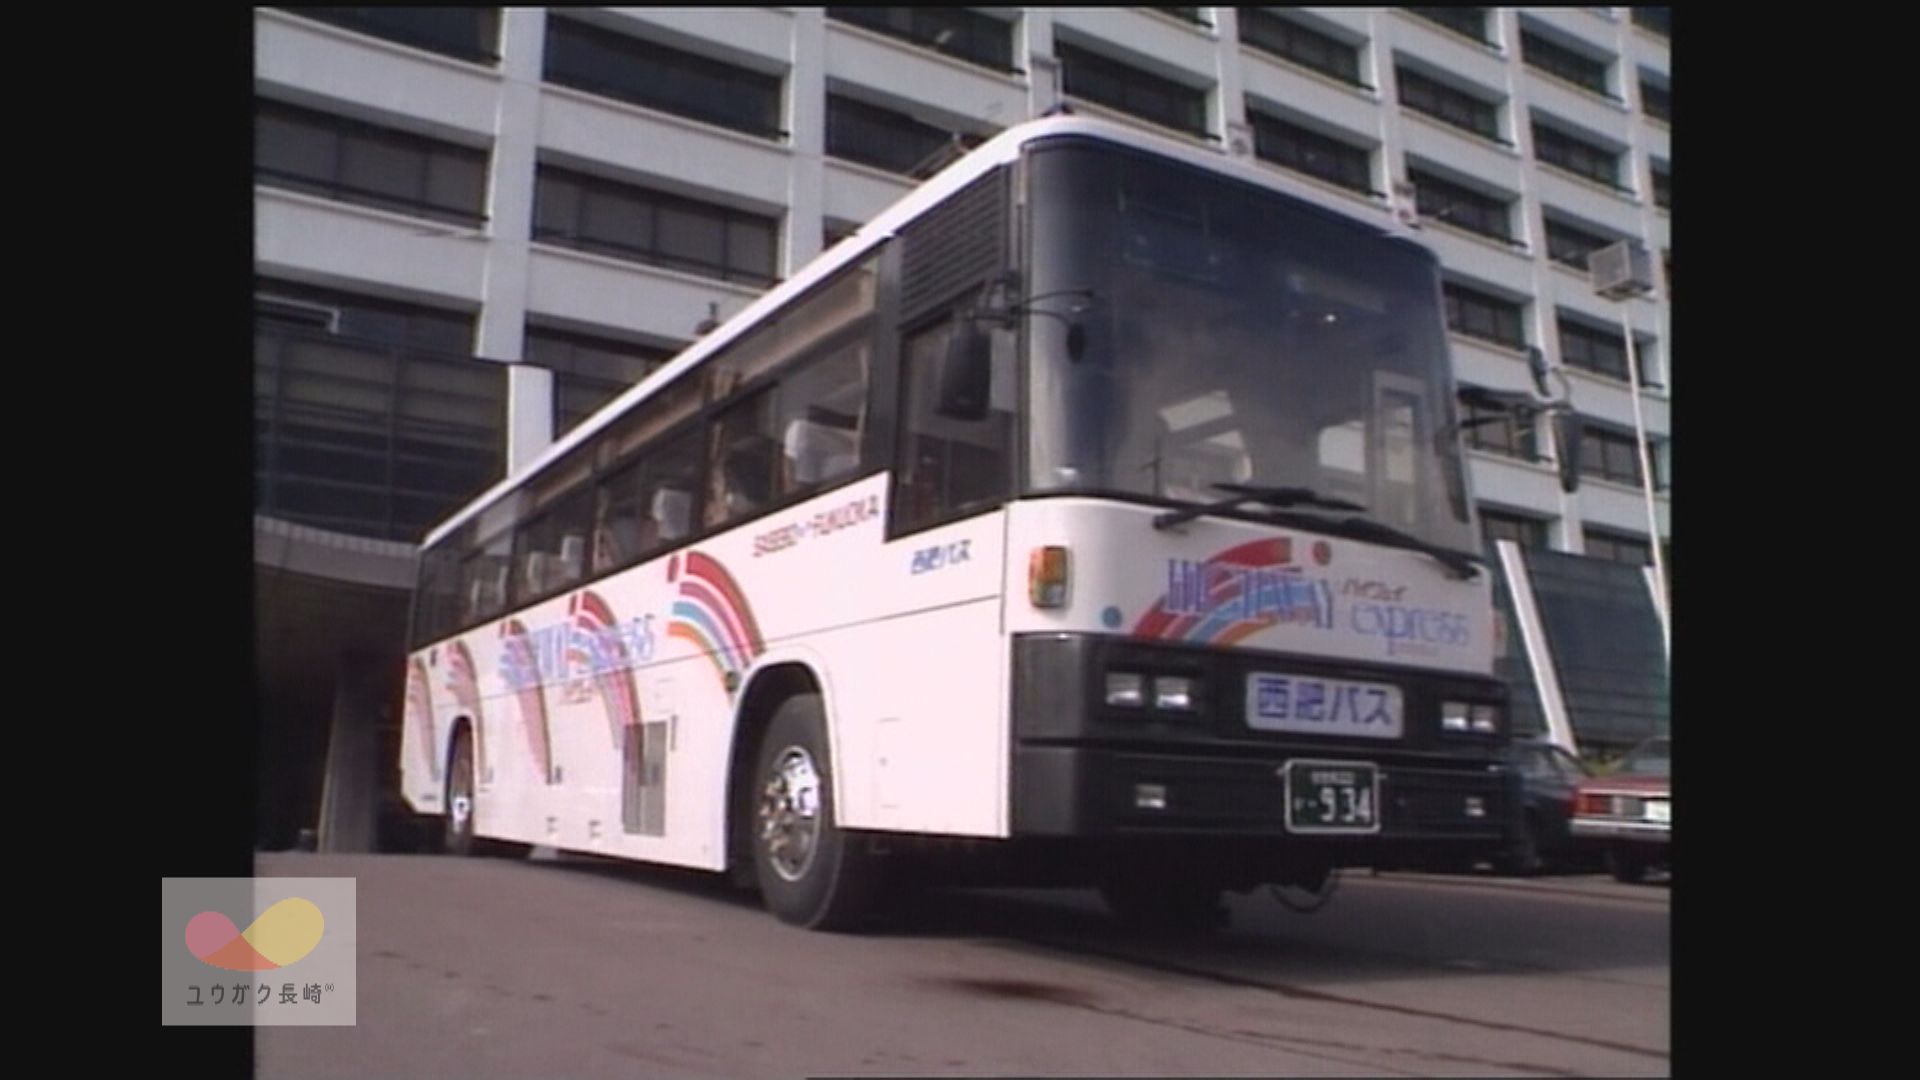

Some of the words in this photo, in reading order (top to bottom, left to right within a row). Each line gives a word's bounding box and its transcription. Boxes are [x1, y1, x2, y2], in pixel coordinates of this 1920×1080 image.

[1350, 604, 1471, 657] express
[1257, 677, 1392, 725] 西肥バス
